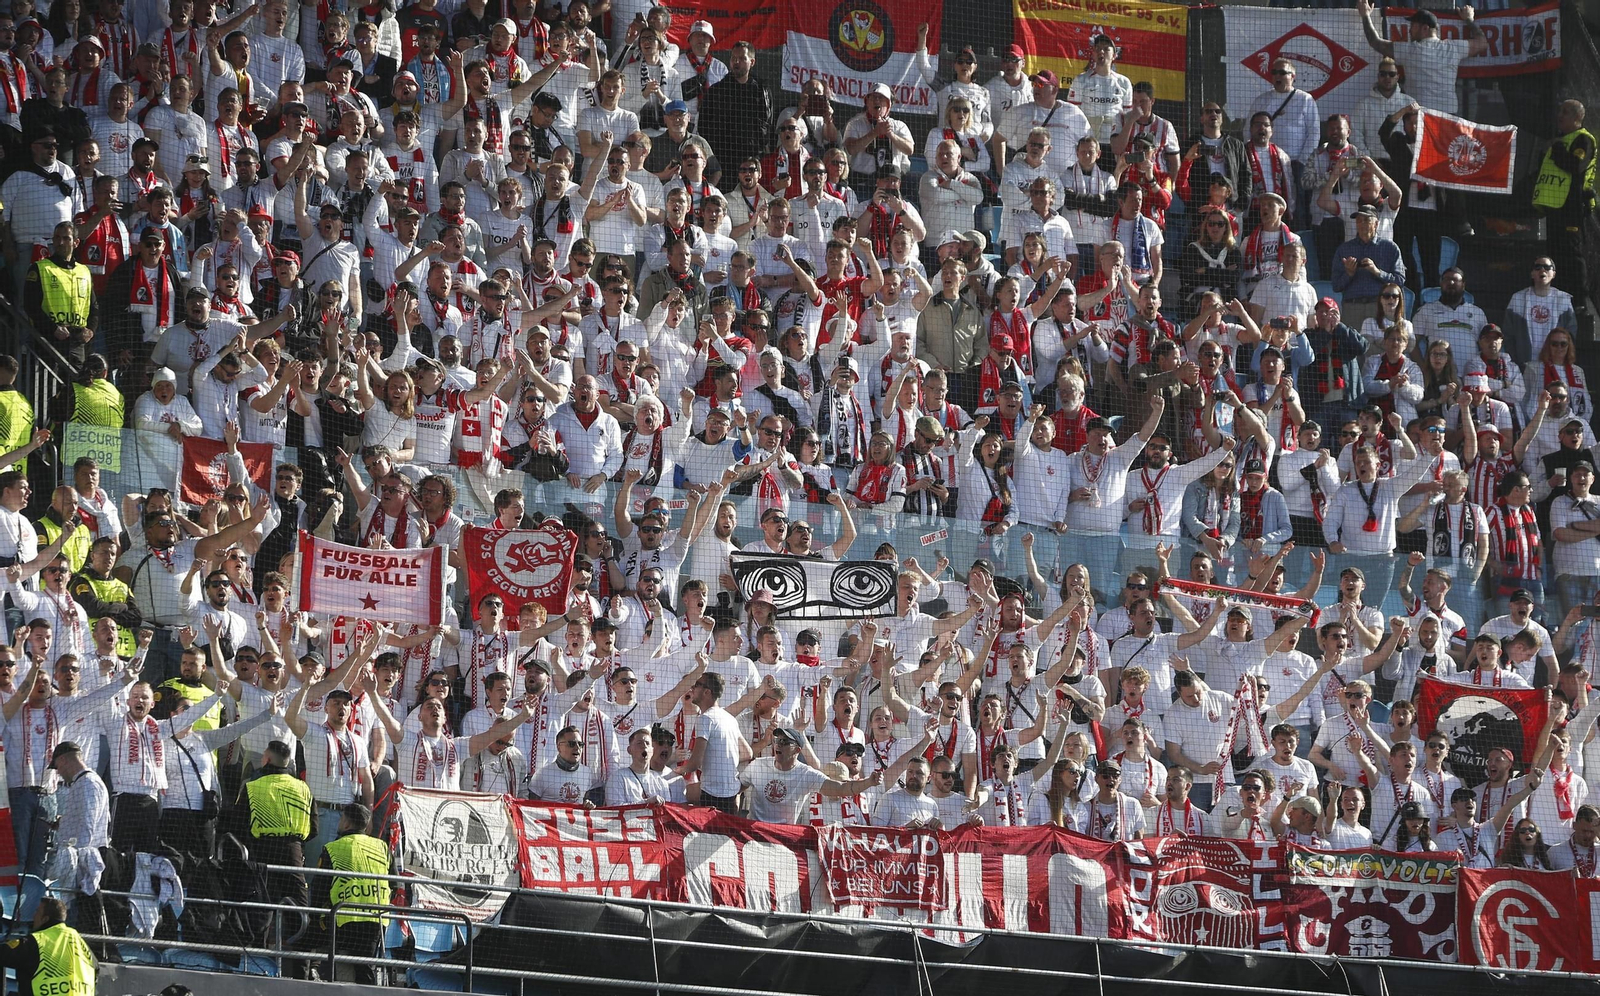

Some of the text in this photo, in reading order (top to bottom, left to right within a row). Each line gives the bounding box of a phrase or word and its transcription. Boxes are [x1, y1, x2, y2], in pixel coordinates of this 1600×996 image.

[1085, 0, 1132, 17] MAGIC
[1136, 7, 1153, 21] 95
[1156, 15, 1181, 29] e.V.
[1061, 76, 1073, 85] FR
[321, 548, 422, 570] FUSSBALL
[323, 564, 418, 587] FÜR ALLE
[486, 568, 528, 598] GEGEN
[1452, 752, 1489, 767] RNATI
[520, 806, 658, 842] FUSS
[825, 832, 938, 857] KHALID
[528, 846, 661, 882] BALL
[872, 860, 938, 878] IMMER
[845, 877, 924, 895] BEI UNS
